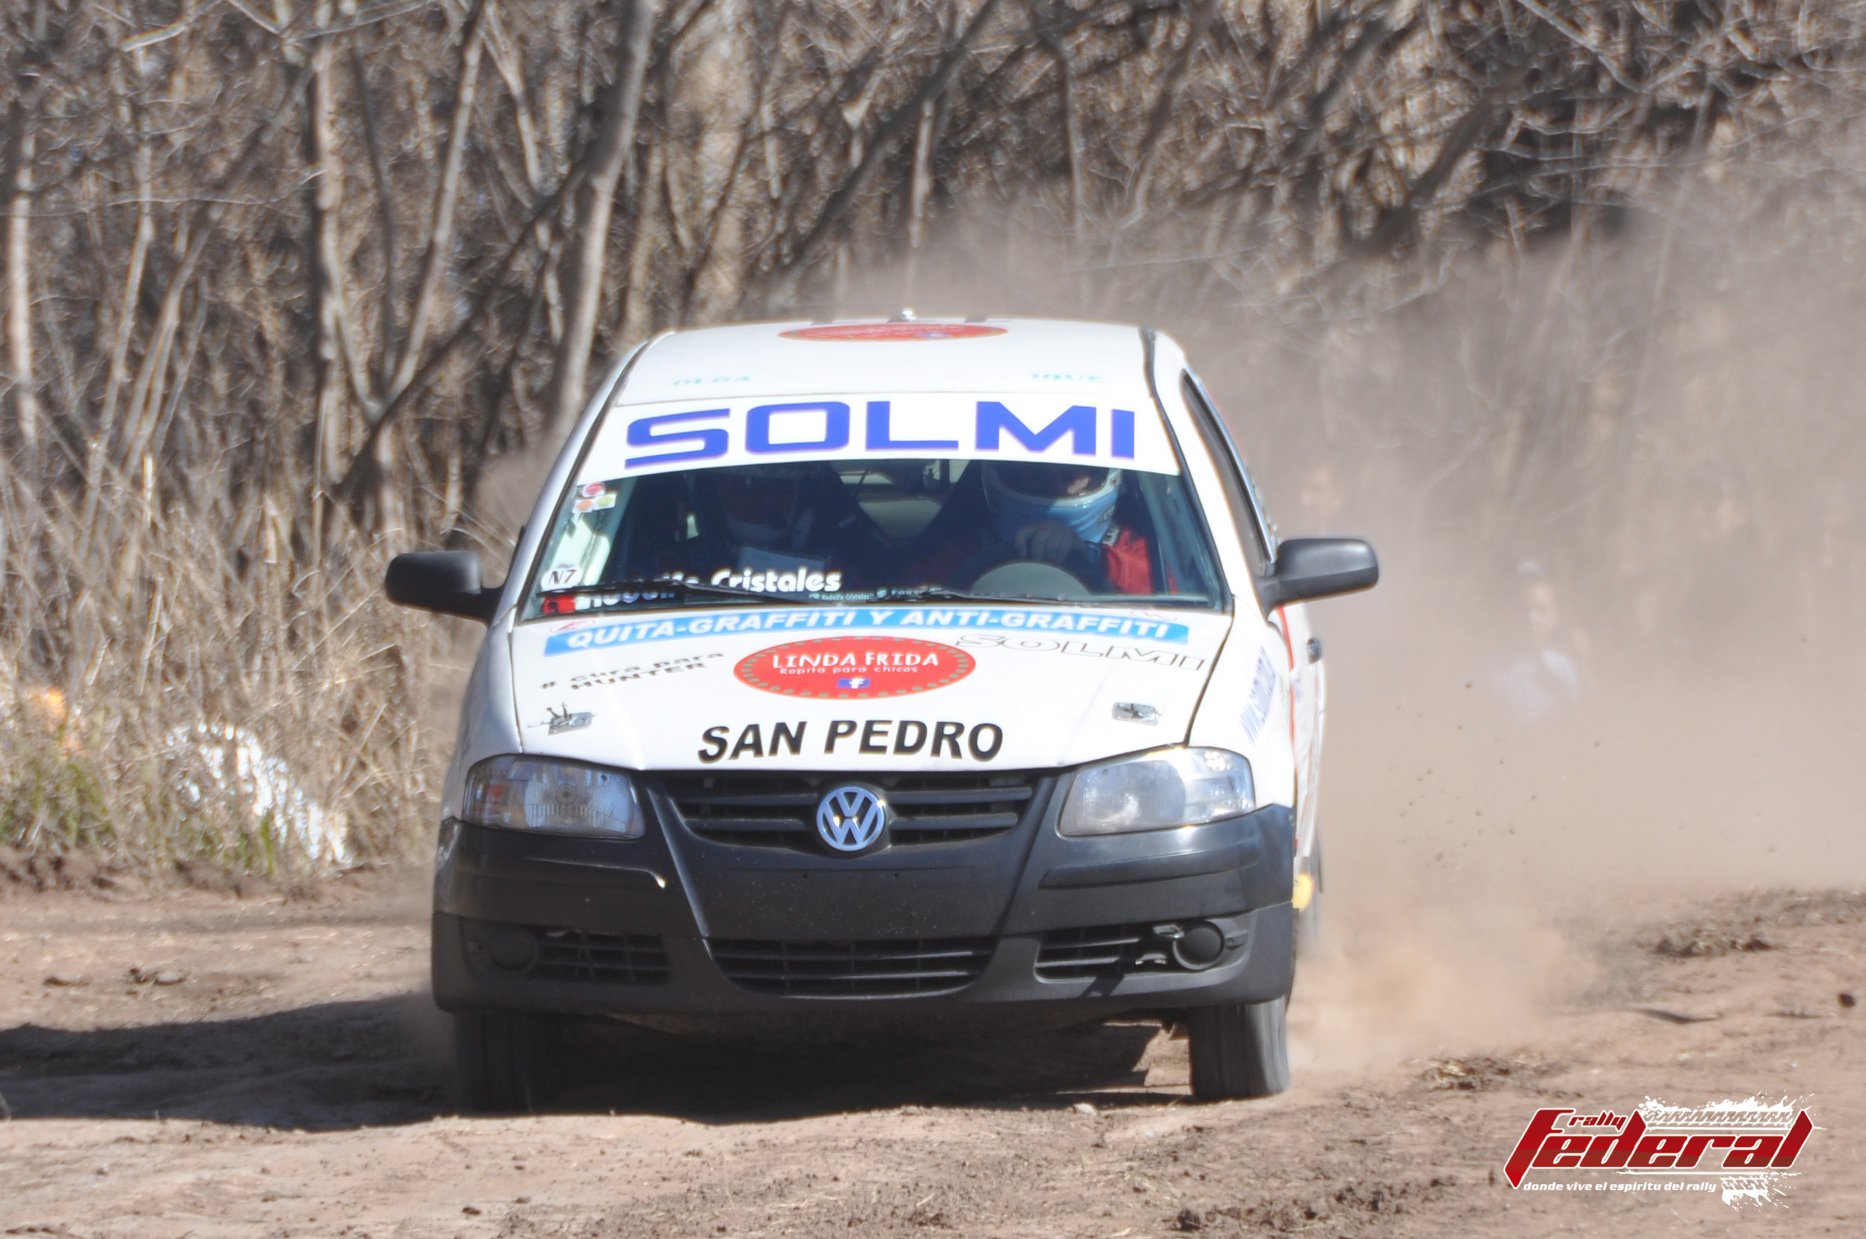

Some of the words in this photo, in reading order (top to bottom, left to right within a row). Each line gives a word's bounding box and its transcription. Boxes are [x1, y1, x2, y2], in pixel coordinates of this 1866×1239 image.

[624, 400, 1135, 470] SOLMI
[548, 568, 577, 585] N7
[711, 567, 841, 593] Cristales
[566, 609, 858, 649] QUITA-GRAFFITI
[869, 610, 892, 624] Y
[900, 610, 1170, 638] ANTI-GRAFFITI
[772, 653, 857, 668] LINDA
[865, 652, 939, 666] FRIDA
[955, 634, 1205, 671] SOLMI
[570, 662, 705, 690] HUNTER
[697, 721, 807, 764] SAN
[824, 720, 1003, 763] PEDRO
